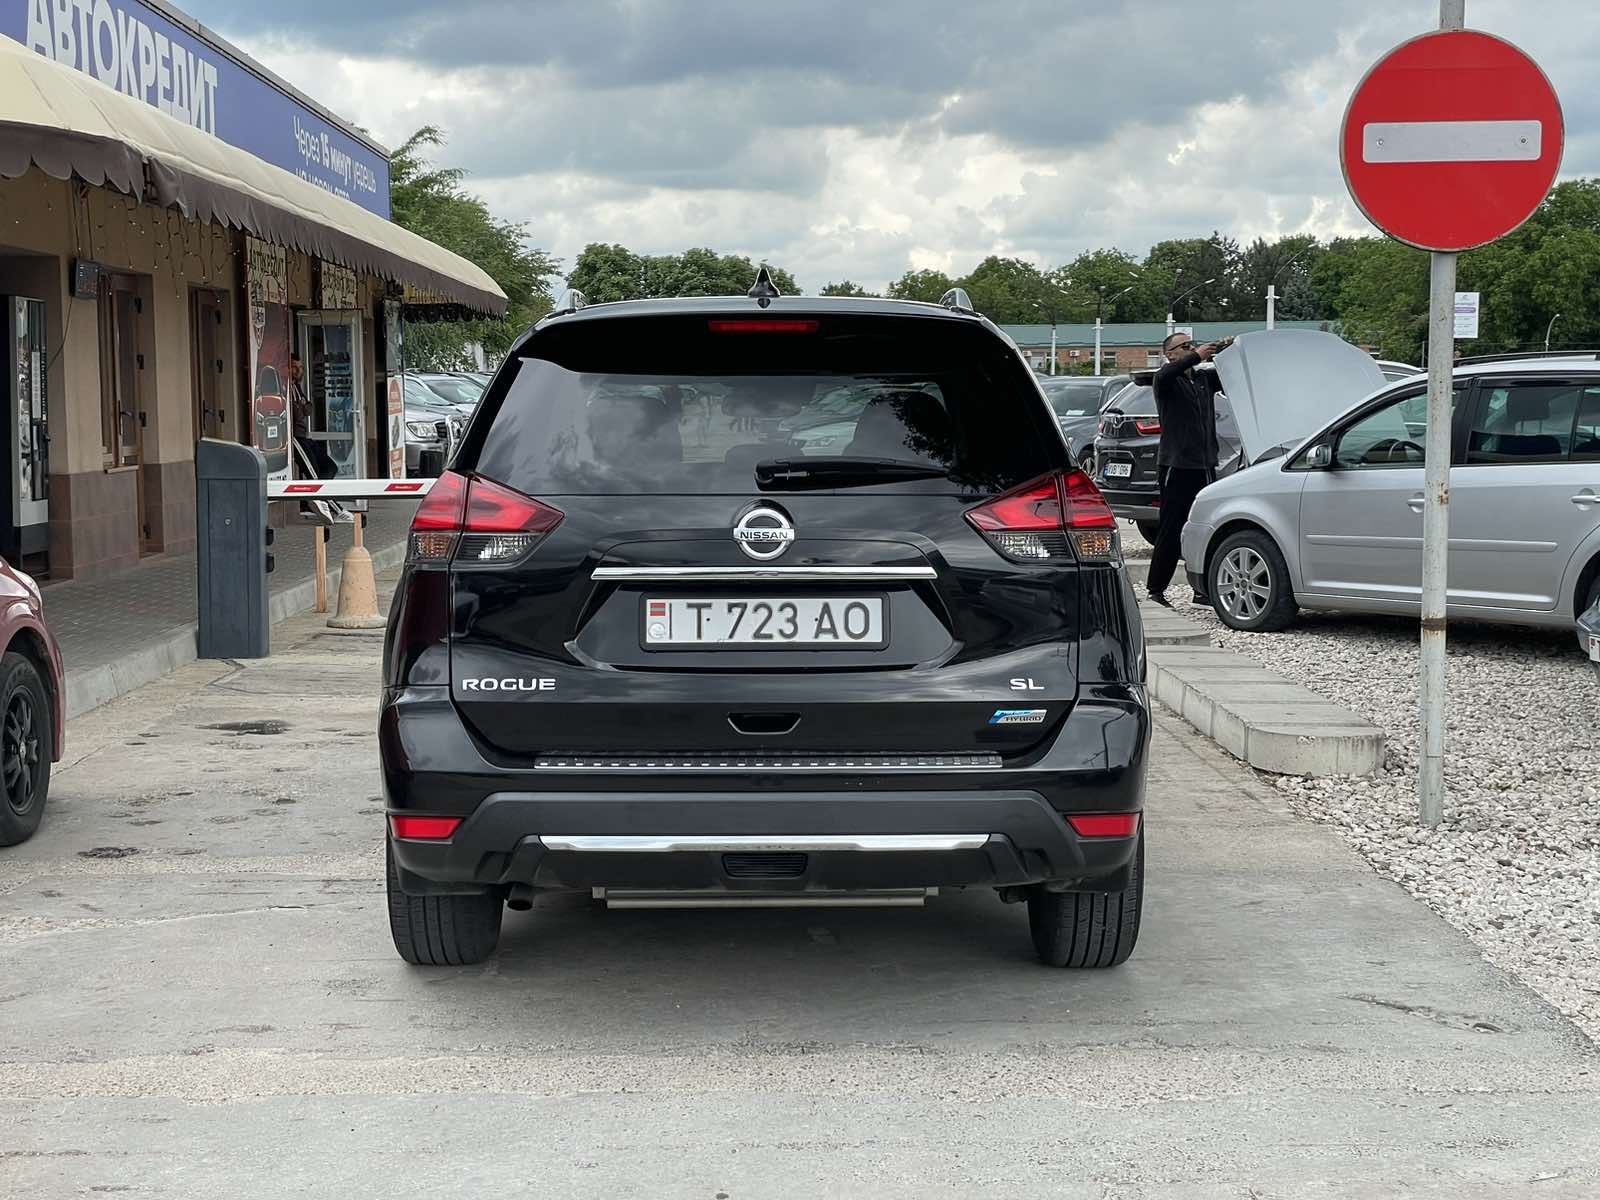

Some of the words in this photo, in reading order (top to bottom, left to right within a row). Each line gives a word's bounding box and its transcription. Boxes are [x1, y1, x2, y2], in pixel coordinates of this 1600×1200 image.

[26, 0, 217, 136] АВТОКРЕДИТ
[293, 115, 320, 167] Через
[320, 132, 330, 169] 15
[330, 146, 352, 187] минут
[740, 531, 788, 539] NISSAN
[686, 602, 713, 640] T
[727, 602, 799, 640] 723
[814, 602, 870, 640] AO
[462, 678, 556, 691] ROGUE
[1010, 679, 1044, 690] SL
